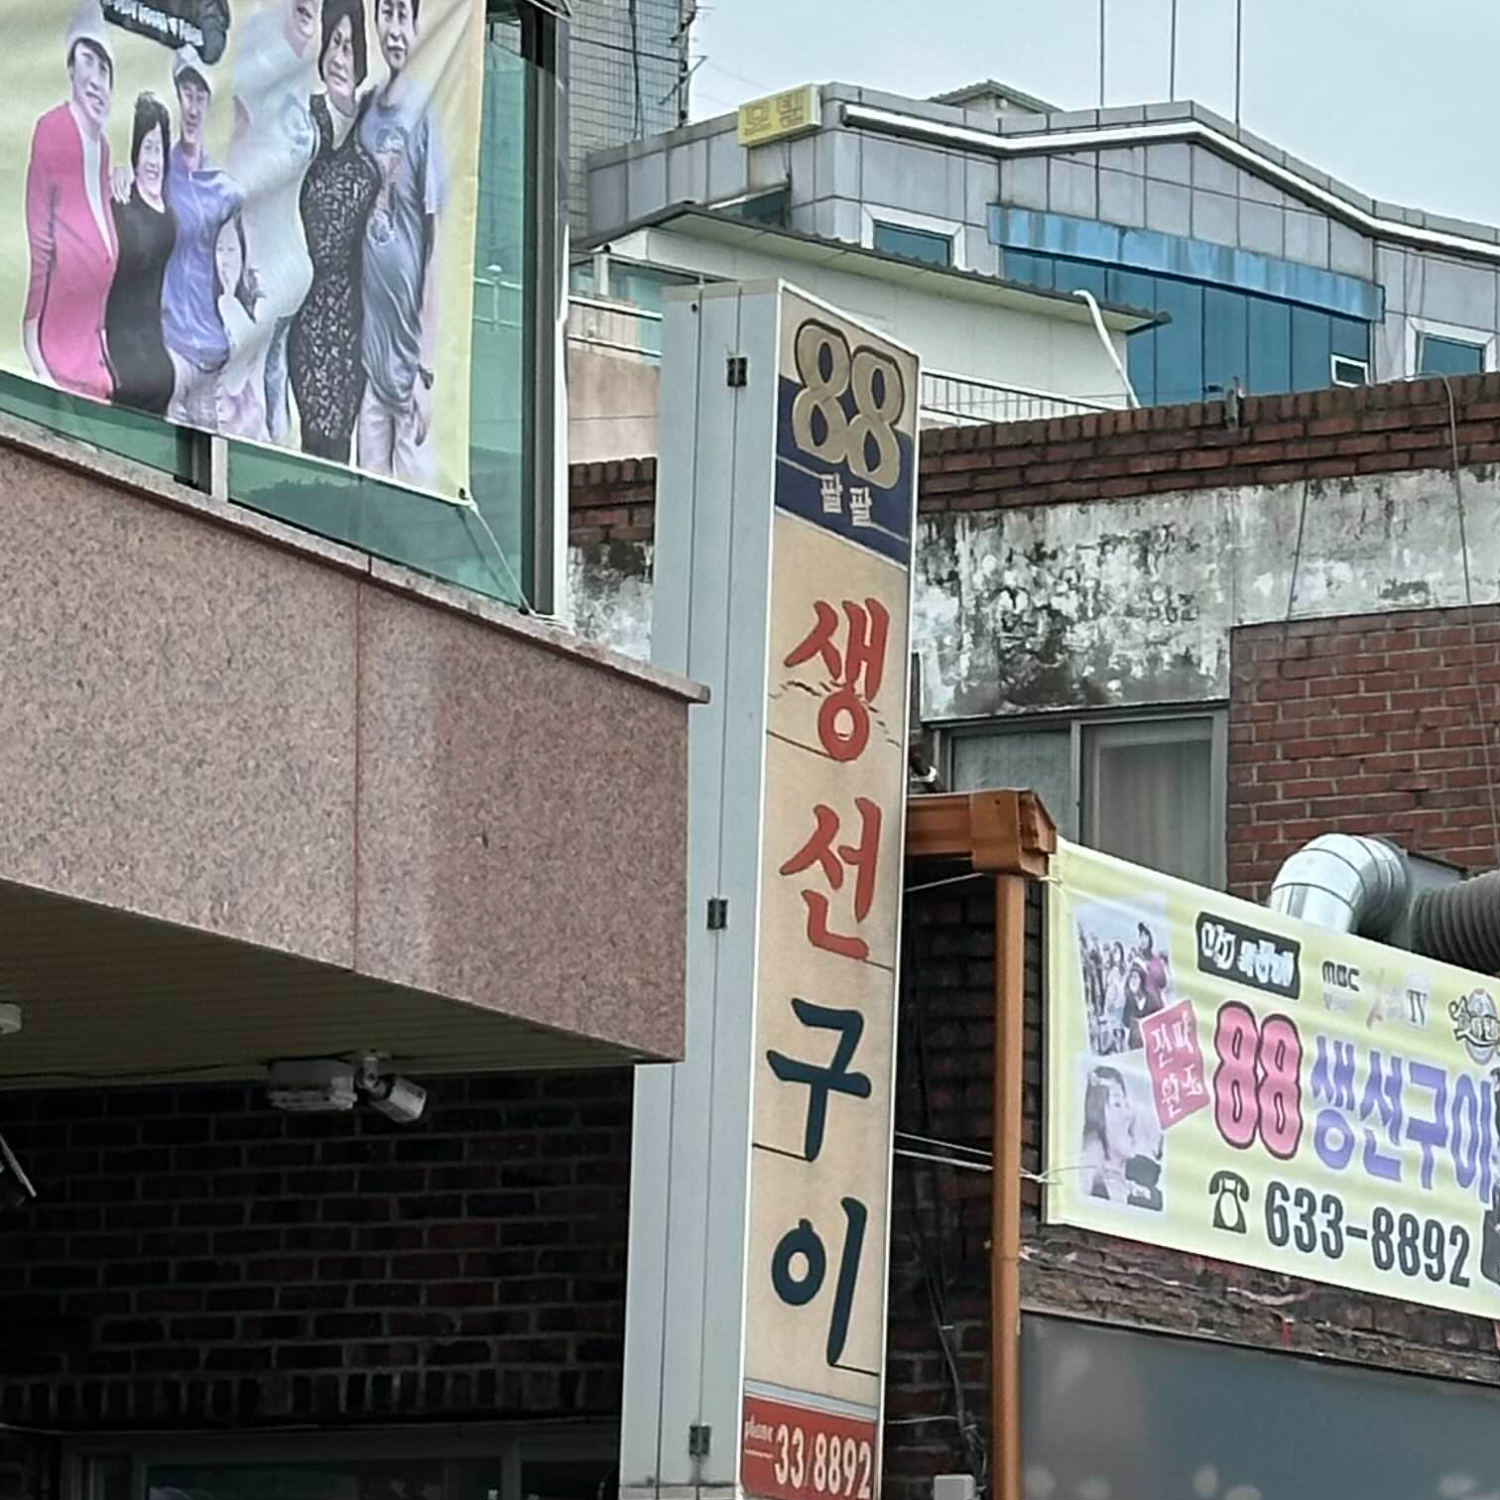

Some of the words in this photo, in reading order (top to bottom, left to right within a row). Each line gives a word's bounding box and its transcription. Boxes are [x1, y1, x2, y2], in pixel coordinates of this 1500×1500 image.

[791, 318, 905, 490] 88
[821, 473, 873, 527] 팔팔
[765, 597, 890, 1366] 생선구이
[1213, 1000, 1303, 1160] 88
[1310, 1035, 1492, 1204] 생선구이
[1264, 1180, 1471, 1288] 633-8892
